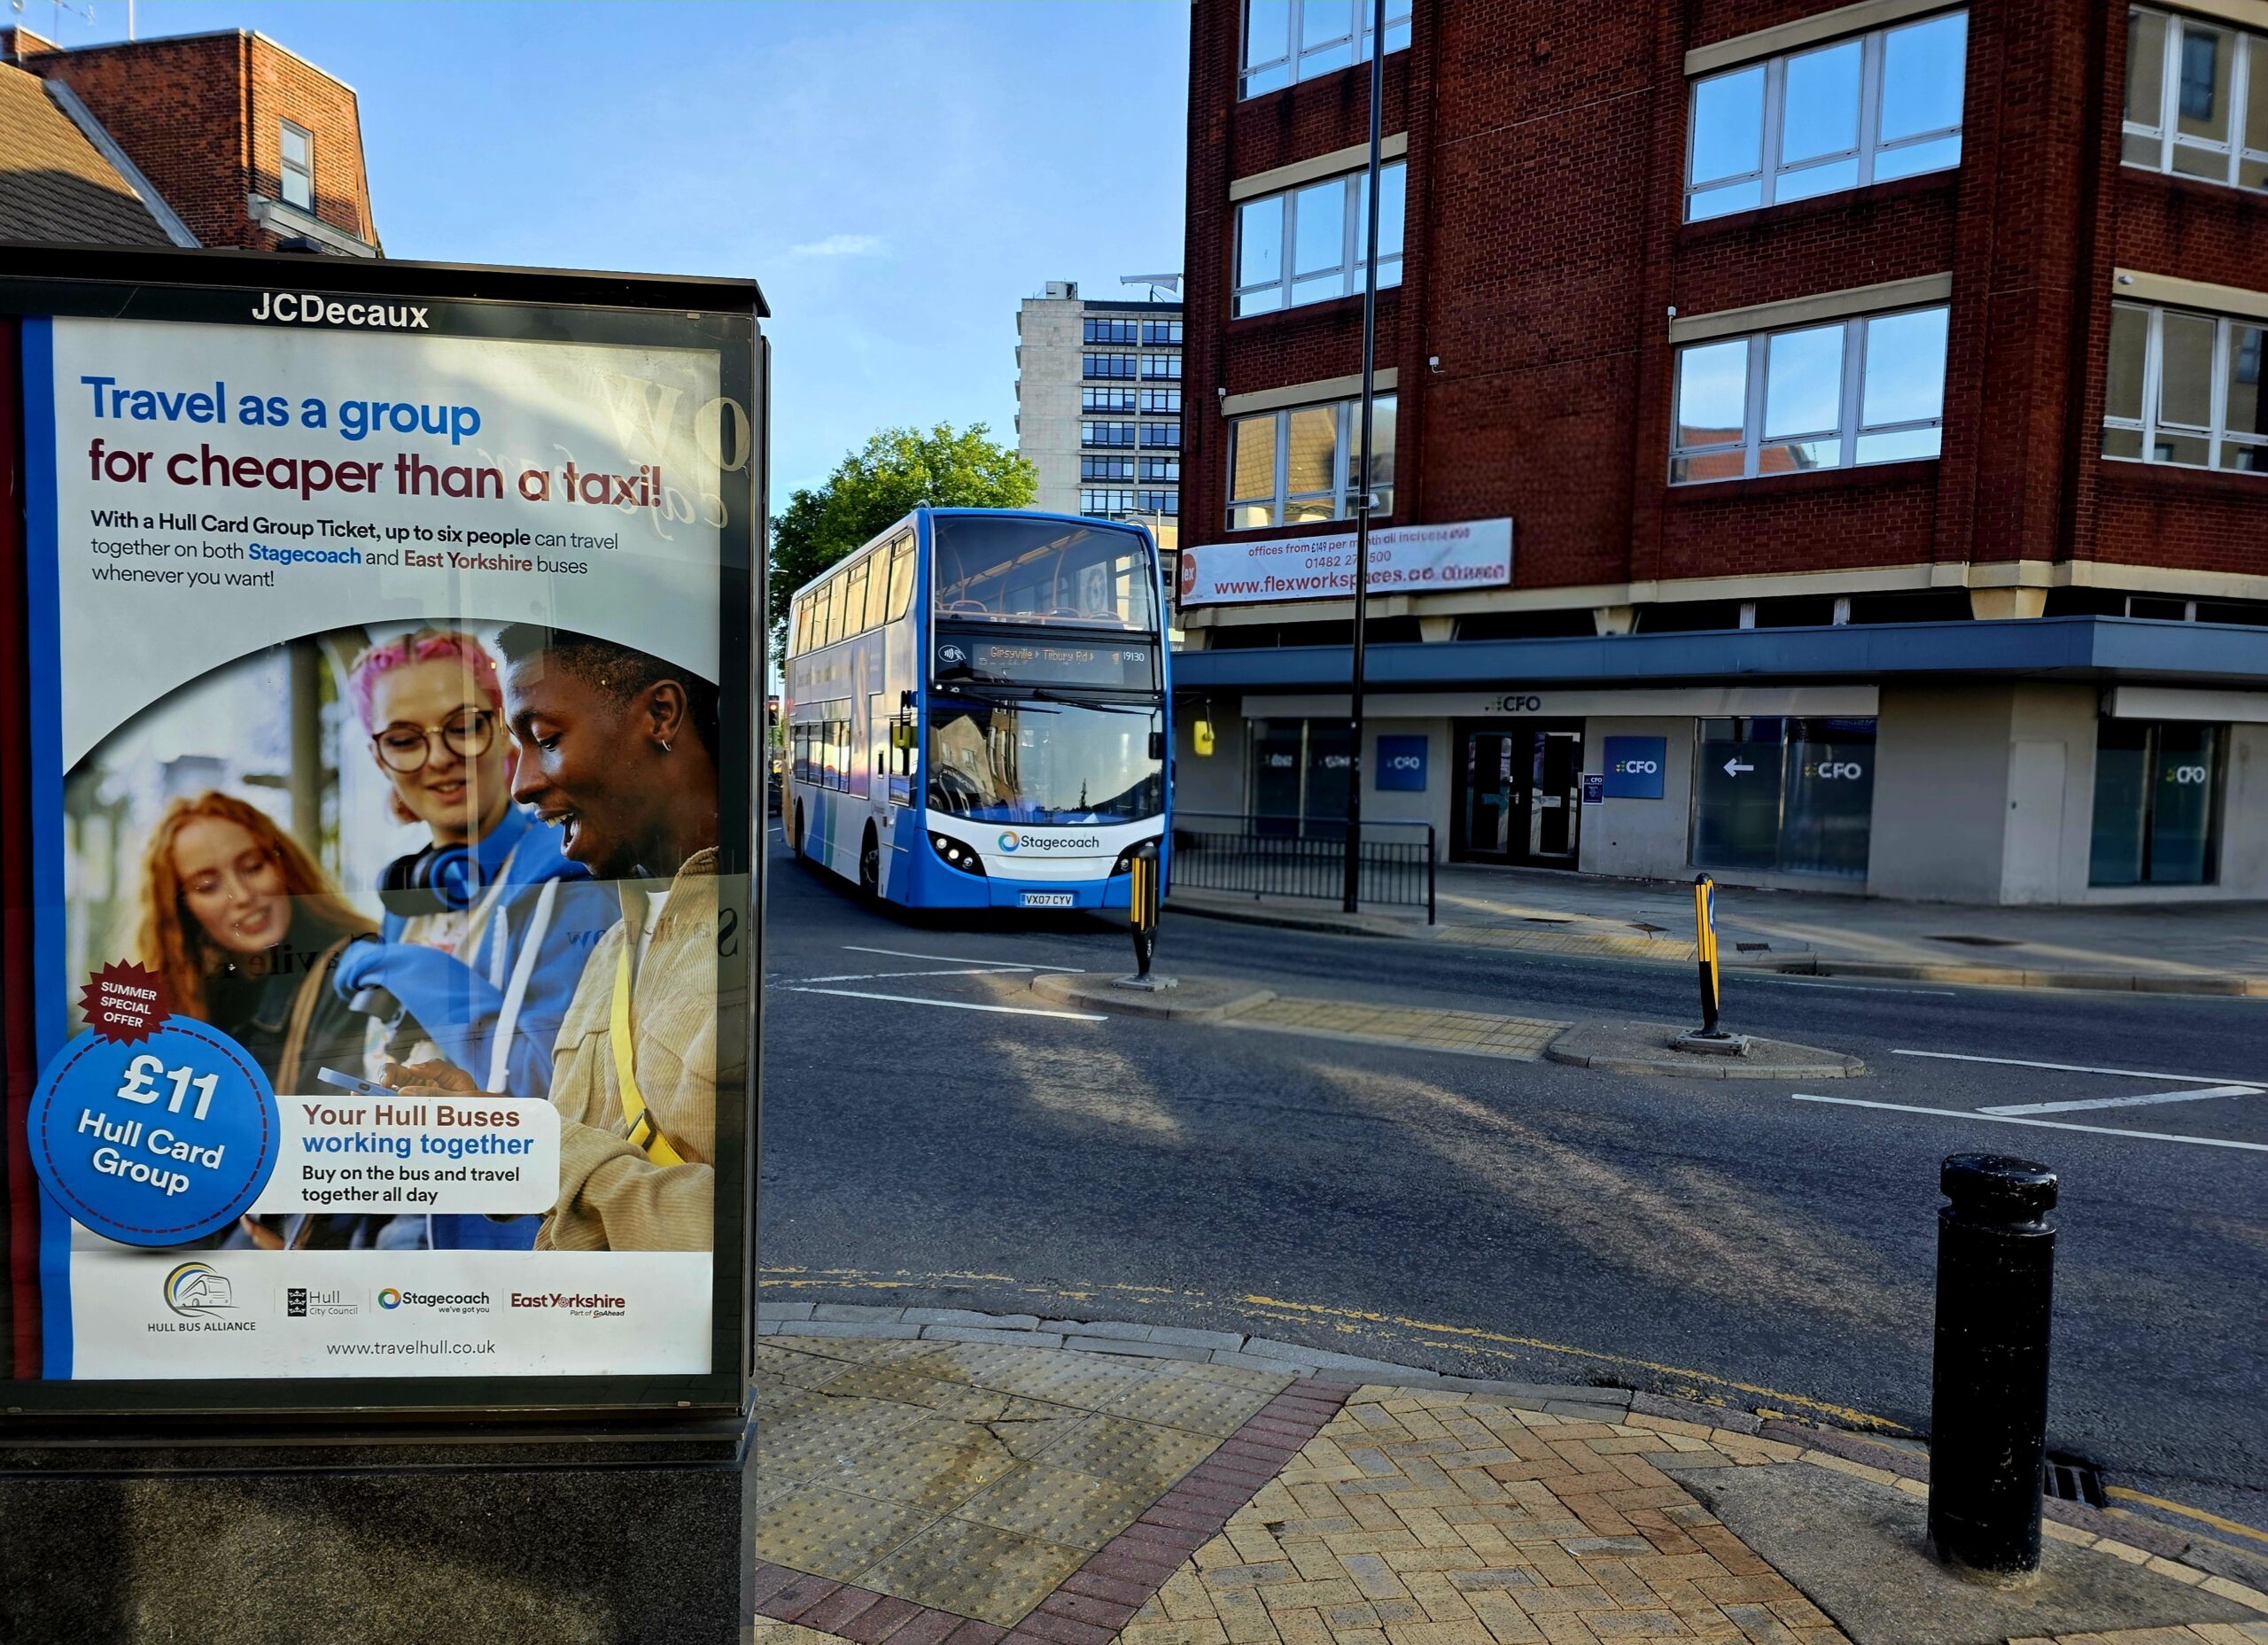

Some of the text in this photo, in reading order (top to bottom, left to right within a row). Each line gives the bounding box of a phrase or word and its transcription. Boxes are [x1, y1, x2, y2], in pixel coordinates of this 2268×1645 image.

[252, 292, 430, 329] JCDecaux
[81, 376, 481, 446] Travel as a group
[89, 438, 661, 508] for cheaper than a taxi!
[91, 509, 618, 550] With a Hull Card Group Ticket, up to six people can travel
[91, 537, 587, 574] together on both Stagecoach and East Yorkshire buses
[1248, 544, 1284, 557] offices
[1285, 542, 1309, 554] from
[1329, 539, 1347, 552] per
[1305, 555, 1340, 569] 01482
[1370, 550, 1392, 563] 500
[92, 564, 275, 588] whenever you want!
[1076, 651, 1088, 662] Rd
[1122, 651, 1146, 663] 19130
[1503, 695, 1542, 711] CFO
[1626, 760, 1657, 773] CFO
[1818, 762, 1861, 779] CFO
[1021, 835, 1099, 850] Stagecoach
[1026, 895, 1072, 905] VX07 CYV
[100, 981, 157, 1001] SUMMER
[100, 996, 152, 1015] SPECIAL
[103, 1012, 144, 1028] OFFER
[116, 1054, 219, 1121] £11
[302, 1104, 520, 1128] Your Hull Buses
[77, 1108, 226, 1170] Hull Card
[302, 1132, 534, 1160] working together
[92, 1147, 190, 1197] Group
[302, 1166, 519, 1183] Buy on the bus and travel
[302, 1186, 439, 1205] together all day
[309, 1291, 340, 1304] Hull
[401, 1292, 490, 1307] Stagecoach
[511, 1292, 625, 1308] East Yorkshire
[309, 1307, 358, 1316] City Council
[148, 1322, 256, 1332] HULL BUS ALLIANCE
[327, 1339, 496, 1355] www.travelhull.co.uk
